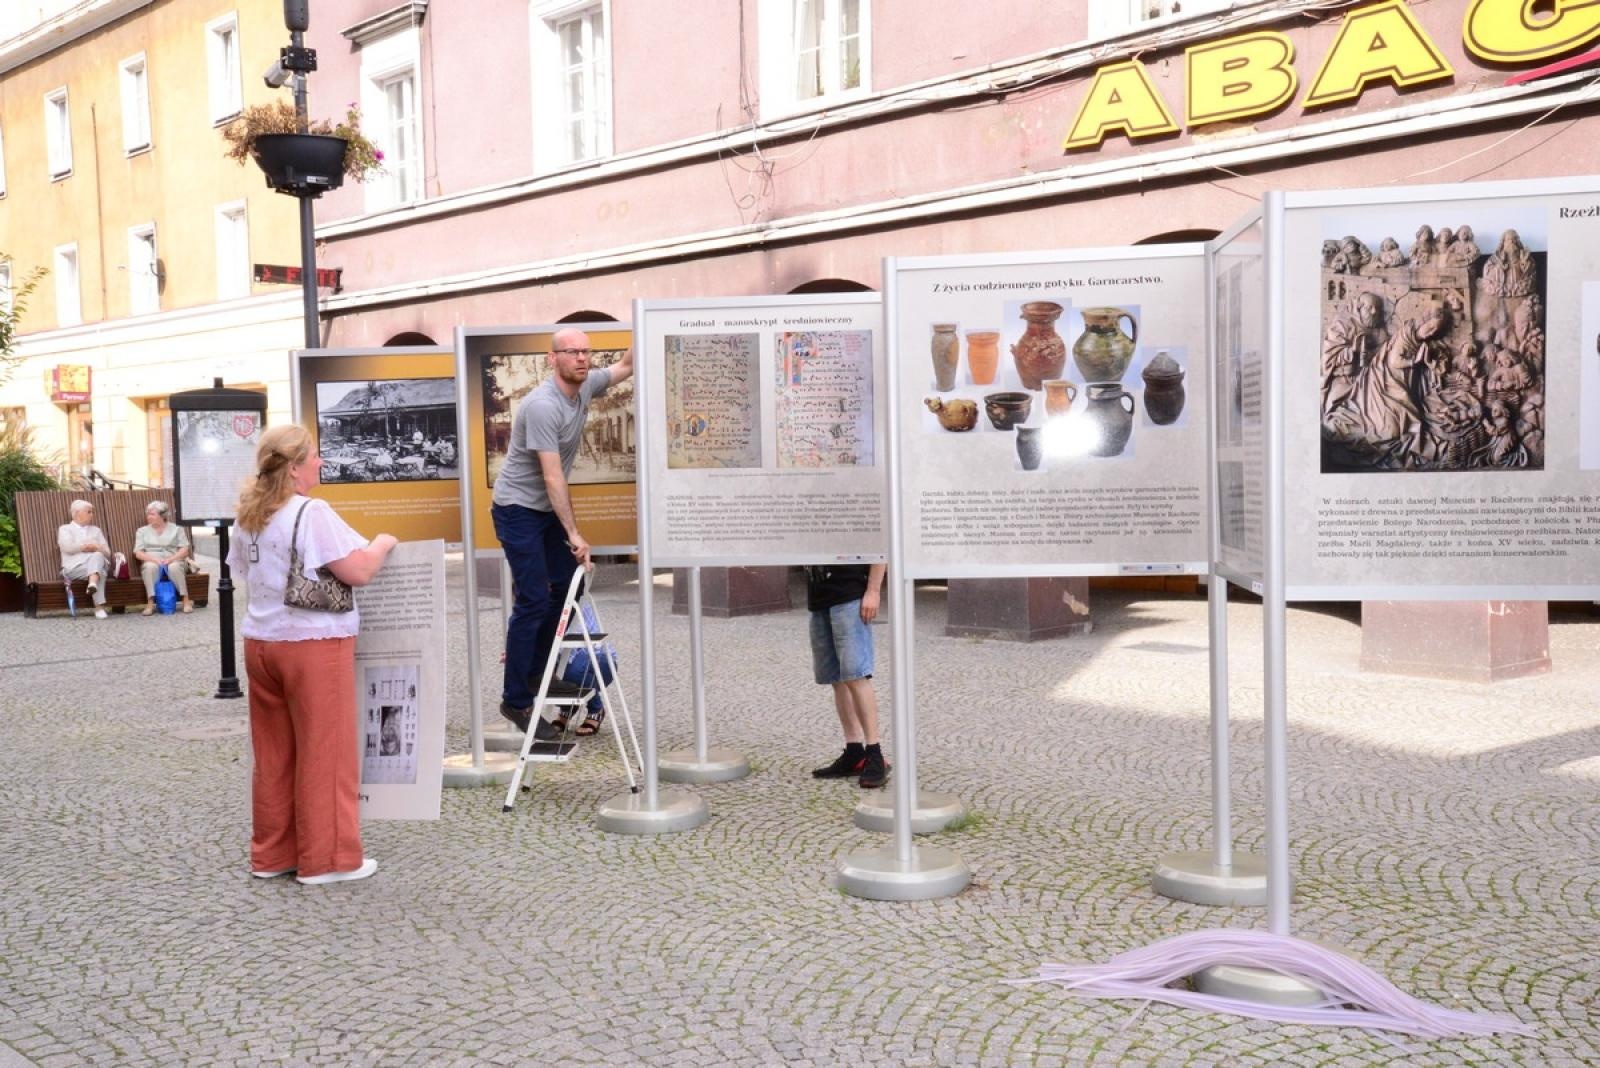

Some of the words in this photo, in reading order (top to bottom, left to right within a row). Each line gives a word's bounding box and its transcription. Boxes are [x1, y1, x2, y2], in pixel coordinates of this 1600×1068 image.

[933, 283, 940, 292] Z
[943, 282, 970, 294] życia
[973, 280, 1042, 292] codziennego
[1044, 278, 1085, 291] gotyku.
[1088, 275, 1164, 286] Garncarstwo.
[724, 317, 778, 328] manuskrypt
[1407, 497, 1436, 506] dawnej
